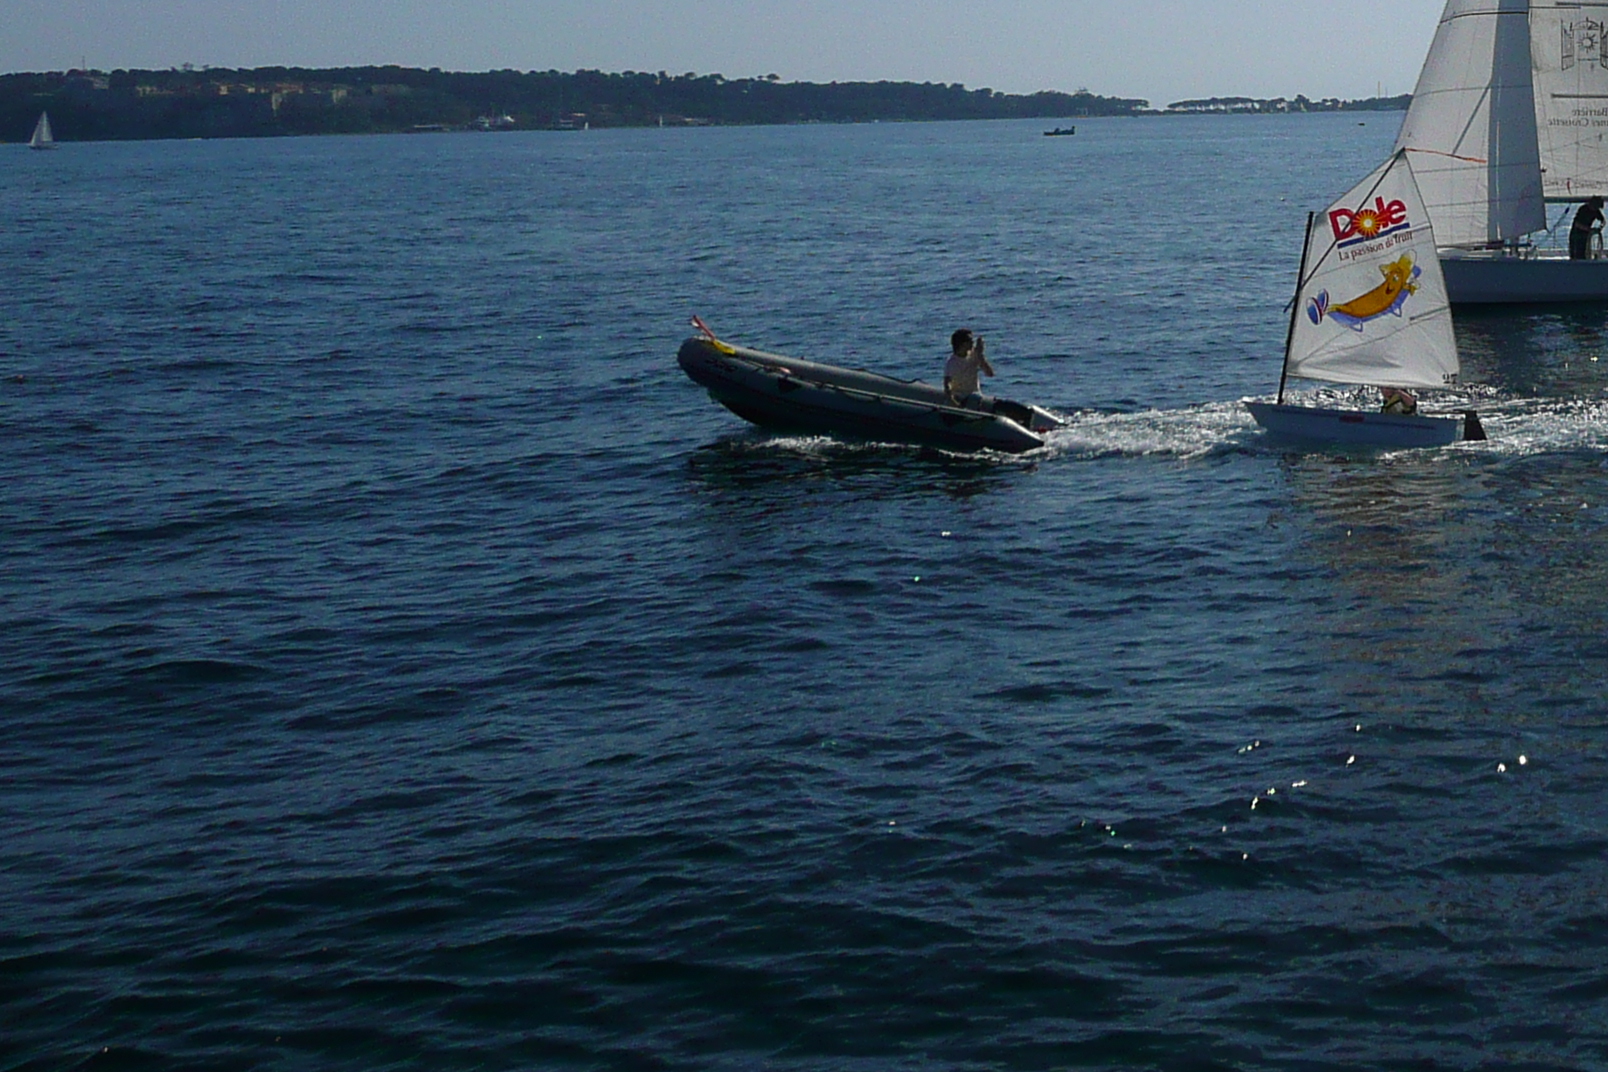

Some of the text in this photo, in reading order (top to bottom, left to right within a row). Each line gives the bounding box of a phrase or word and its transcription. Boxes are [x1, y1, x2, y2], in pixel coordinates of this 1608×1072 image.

[1329, 196, 1407, 240] Dole
[1338, 251, 1350, 261] La
[1351, 243, 1384, 260] passion
